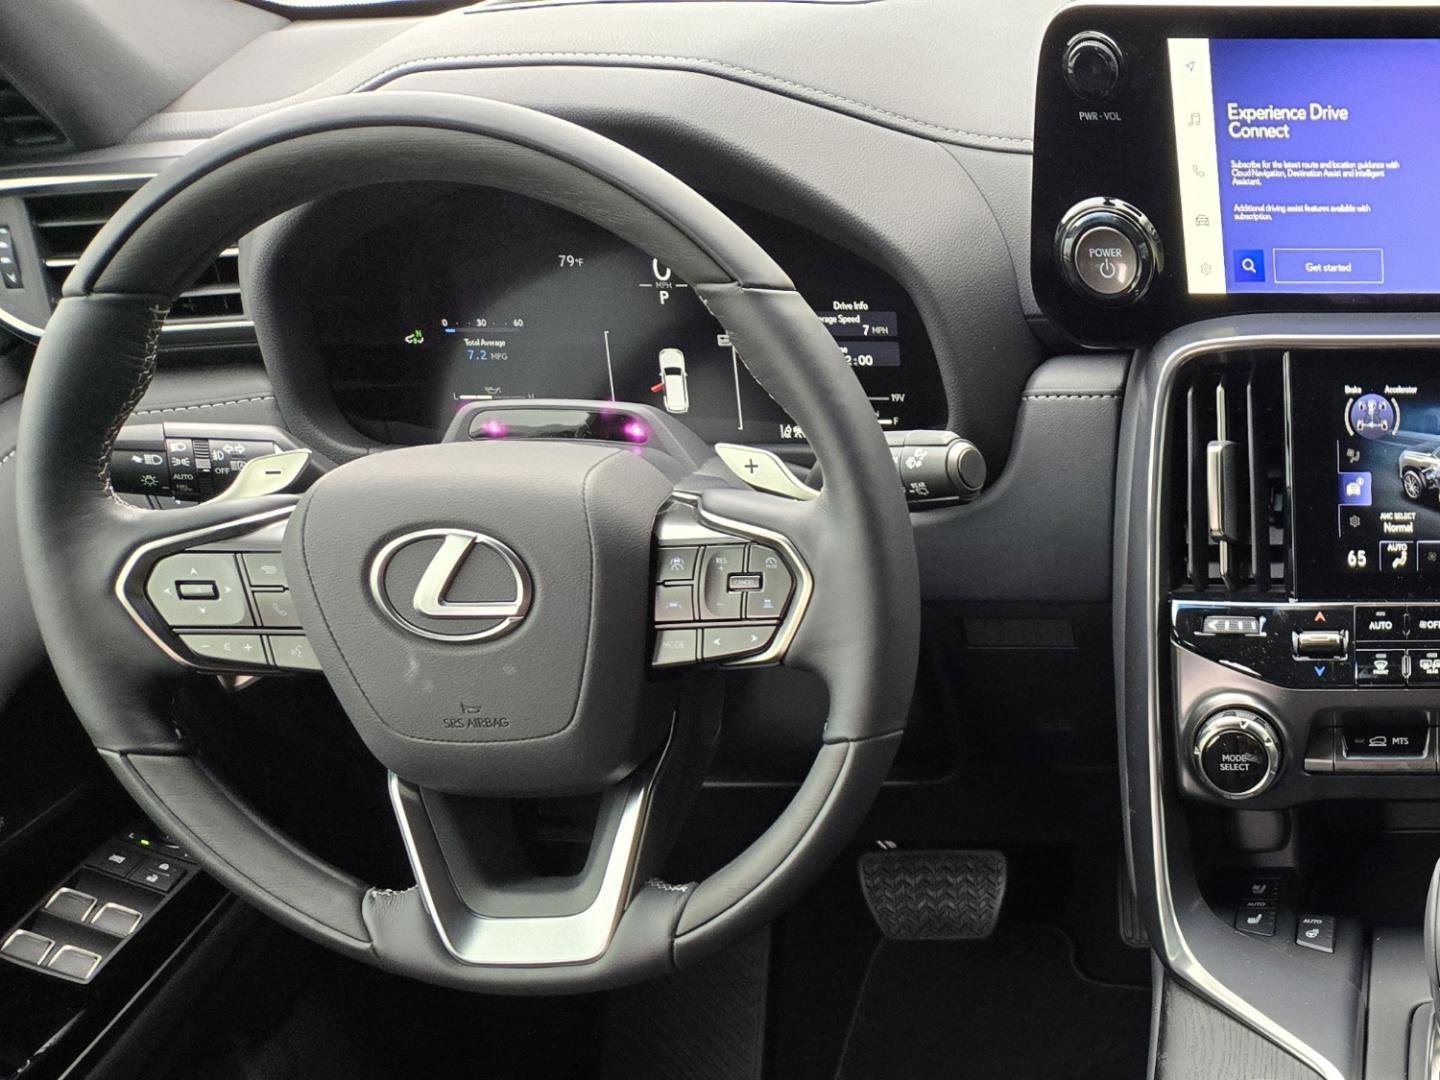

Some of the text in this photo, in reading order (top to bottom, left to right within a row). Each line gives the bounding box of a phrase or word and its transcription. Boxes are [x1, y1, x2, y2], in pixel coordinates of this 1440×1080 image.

[1227, 102, 1349, 123] Experience Drive
[1228, 122, 1290, 139] Connect
[1230, 160, 1261, 169] Subscribe
[1262, 160, 1271, 168] for
[1272, 160, 1283, 168] the
[1283, 160, 1301, 168] latest
[1319, 160, 1332, 169] and
[1357, 160, 1385, 170] guidance
[1385, 160, 1401, 169] with
[1231, 168, 1251, 177] Cloud
[1233, 203, 1265, 212] Additional
[1265, 203, 1286, 214] driving
[1356, 203, 1373, 212] with
[1089, 248, 1122, 258] POWER
[1305, 261, 1352, 273] Get started
[659, 290, 669, 305] P
[833, 301, 869, 310] Drive Info
[476, 318, 487, 327] 30
[513, 318, 524, 327] 60
[838, 314, 860, 324] Speed
[862, 324, 889, 336] 7 MPH
[463, 338, 506, 348] Total Average
[467, 349, 508, 361] 7.2 MPG
[1384, 385, 1418, 394] Accelerator
[1383, 522, 1413, 533] Normal
[1387, 543, 1408, 552] AUTO
[1347, 550, 1367, 567] 65
[1368, 621, 1393, 630] AUTO
[1392, 737, 1409, 745] MTS
[1222, 754, 1247, 762] MODE
[1219, 763, 1250, 771] SELECT
